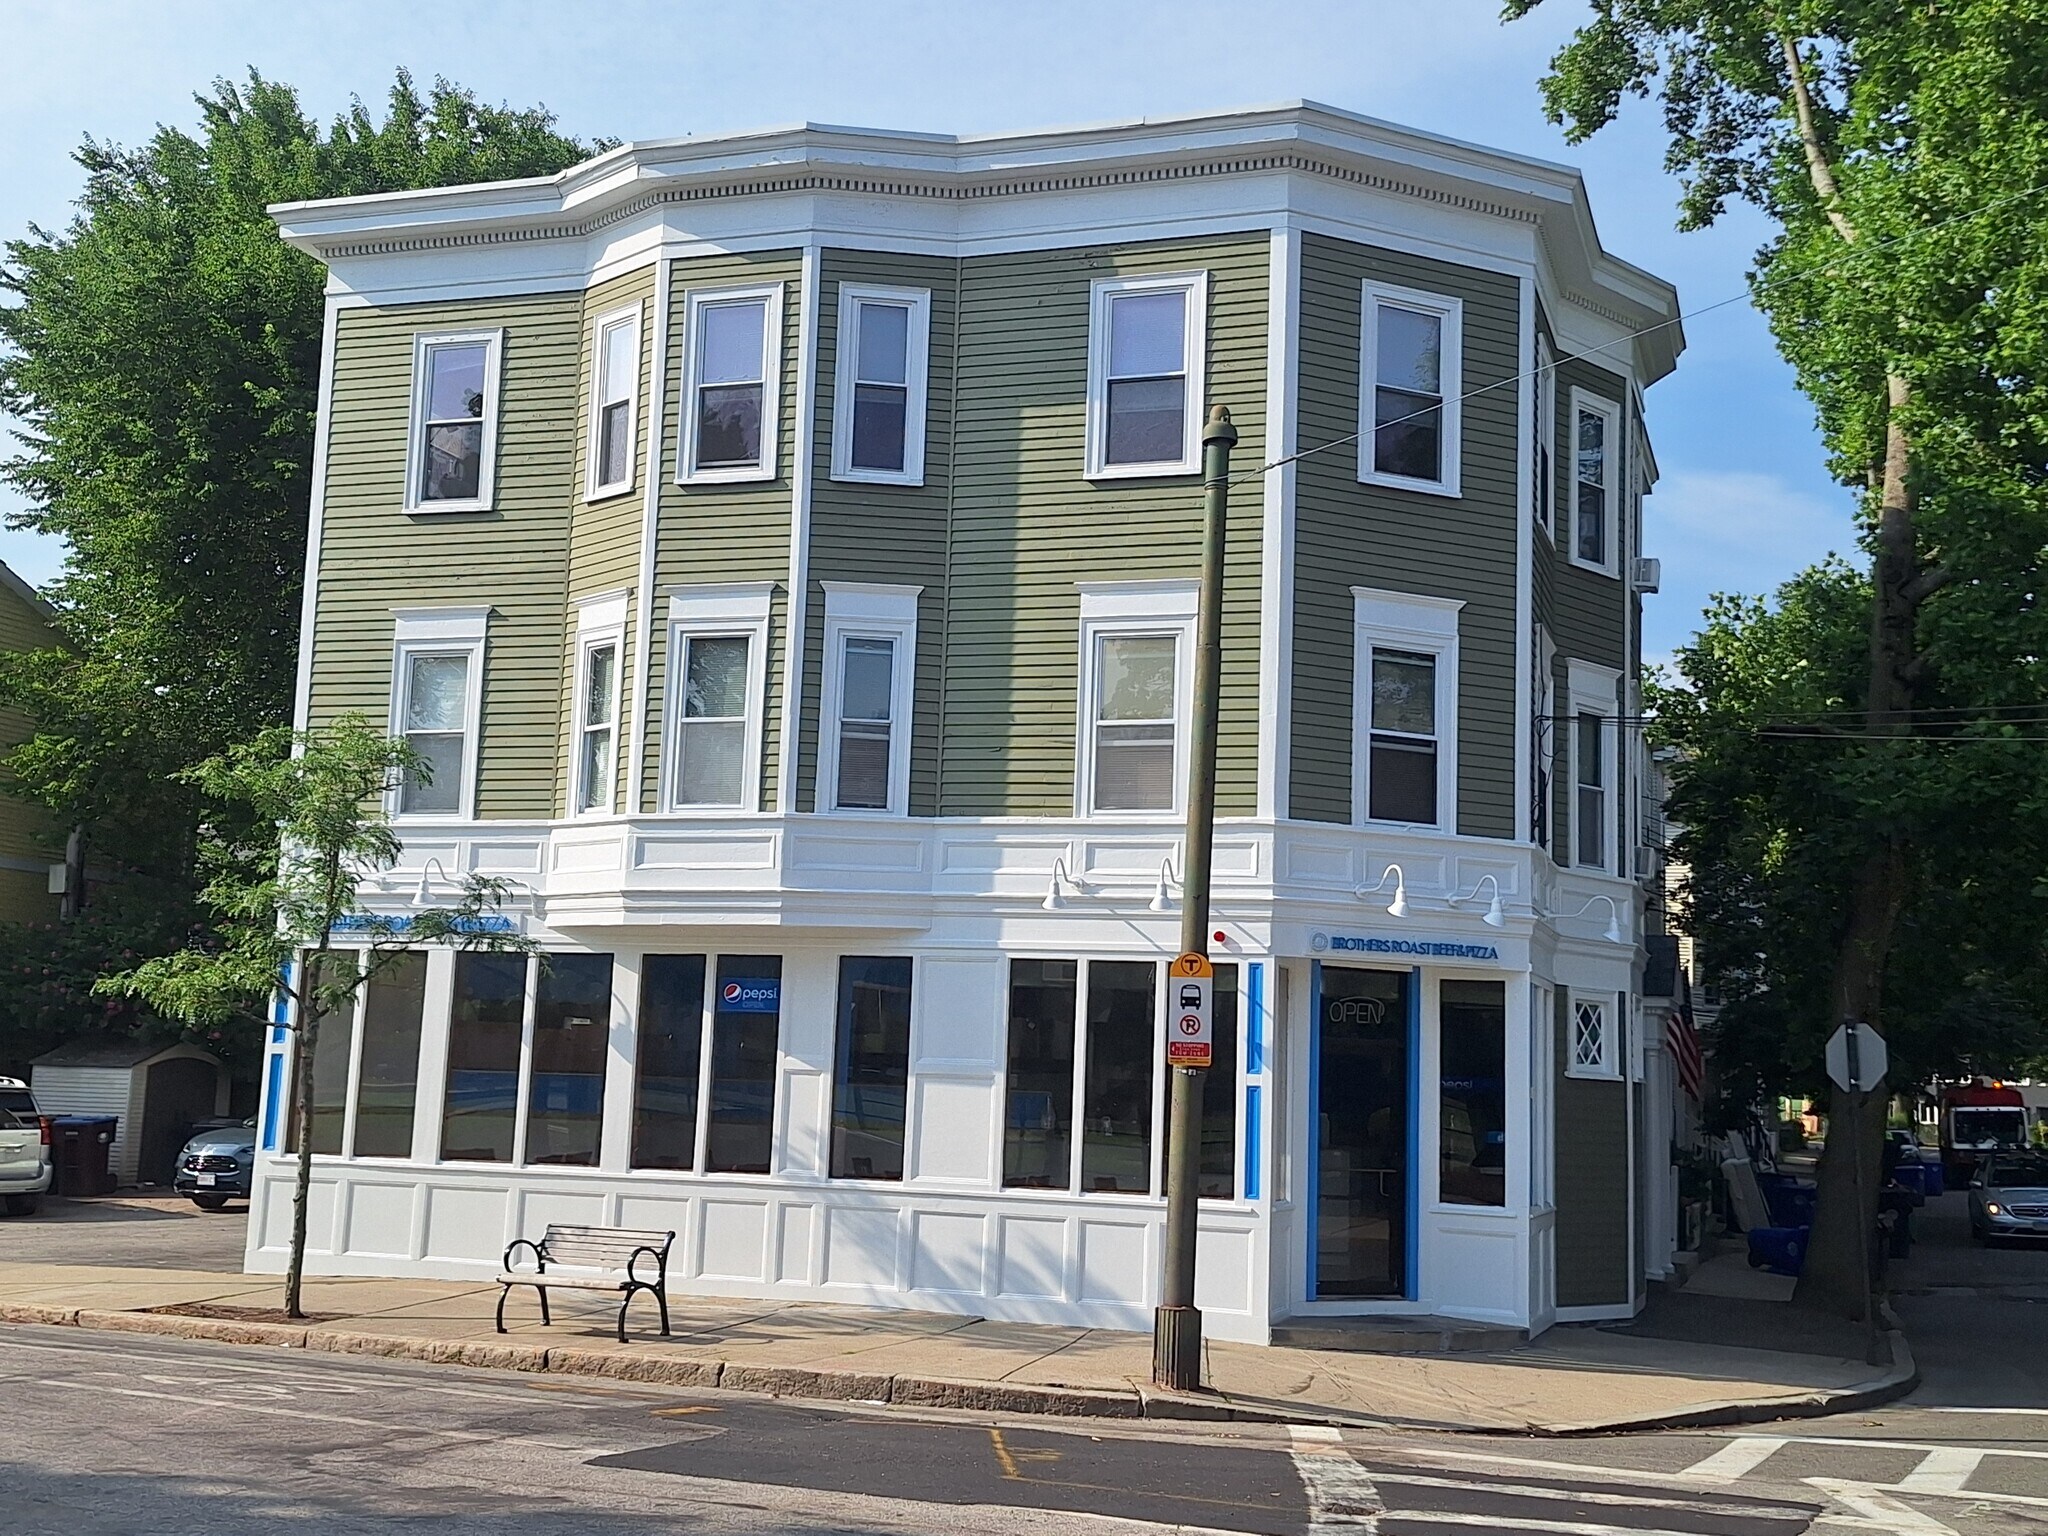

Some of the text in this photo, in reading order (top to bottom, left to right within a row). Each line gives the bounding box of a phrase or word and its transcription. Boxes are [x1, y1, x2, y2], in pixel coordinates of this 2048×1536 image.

[1331, 936, 1391, 953] BROTHERS
[1391, 940, 1432, 955] ROAST
[742, 987, 778, 1001] pepsi
[1329, 1001, 1382, 1025] OPEN
